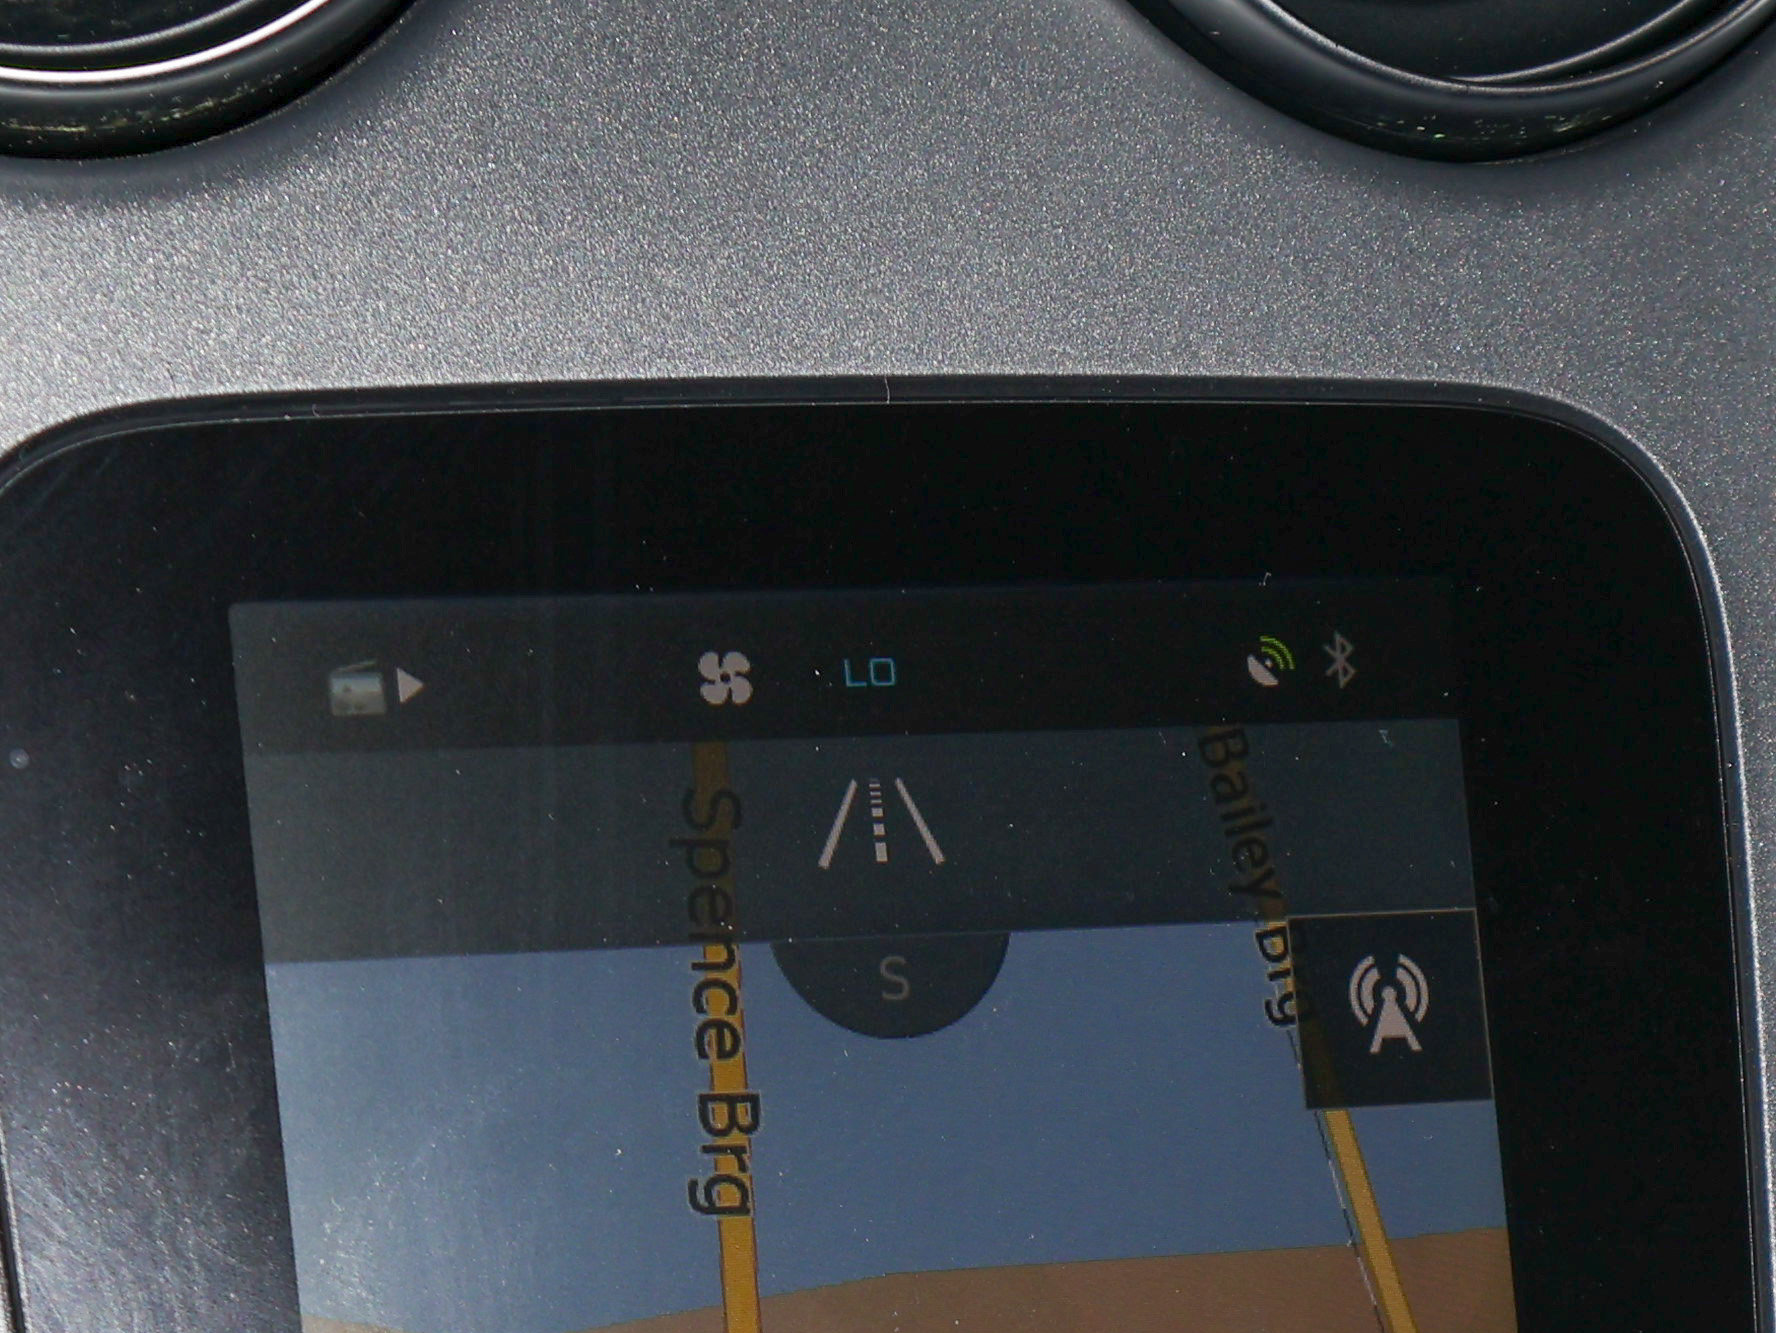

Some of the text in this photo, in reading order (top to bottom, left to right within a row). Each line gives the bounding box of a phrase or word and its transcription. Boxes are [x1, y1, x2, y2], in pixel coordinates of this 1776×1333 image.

[843, 656, 897, 688] LO
[1198, 727, 1284, 901] Bailey
[669, 788, 761, 1217] Spence Brg
[879, 955, 910, 1001] S
